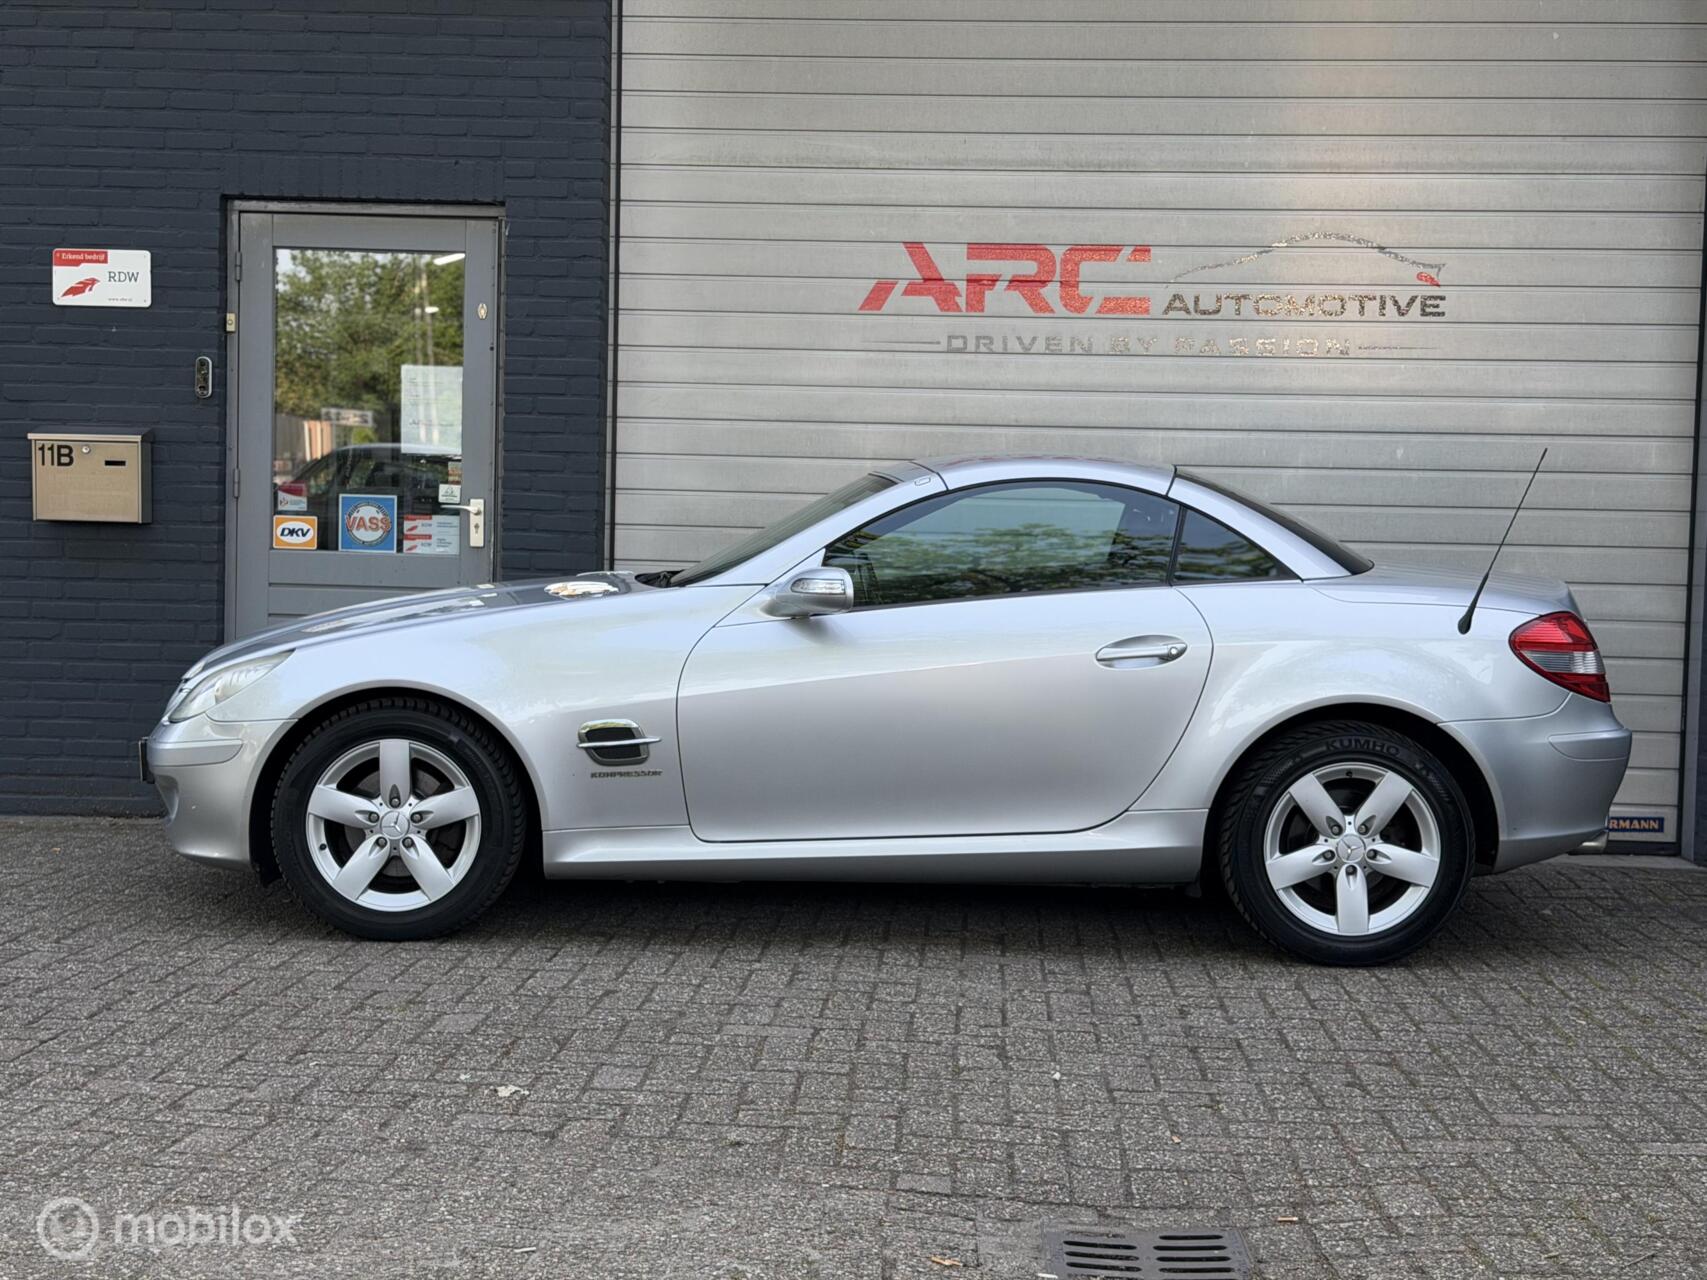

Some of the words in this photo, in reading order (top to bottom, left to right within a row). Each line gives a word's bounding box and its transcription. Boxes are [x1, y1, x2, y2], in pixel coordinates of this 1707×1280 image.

[108, 271, 139, 282] RDW
[858, 242, 1152, 315] ARC
[1162, 293, 1446, 317] AUTOMOTIVE
[946, 335, 1093, 353] DRIVEN
[1109, 336, 1158, 355] BY
[1174, 336, 1350, 357] PASSION
[37, 444, 75, 467] 11B
[280, 527, 311, 538] DKV
[346, 515, 391, 533] VASS
[1325, 737, 1402, 757] KUMHO
[591, 770, 662, 779] KOMPRESSOR
[1609, 819, 1659, 829] RMANN
